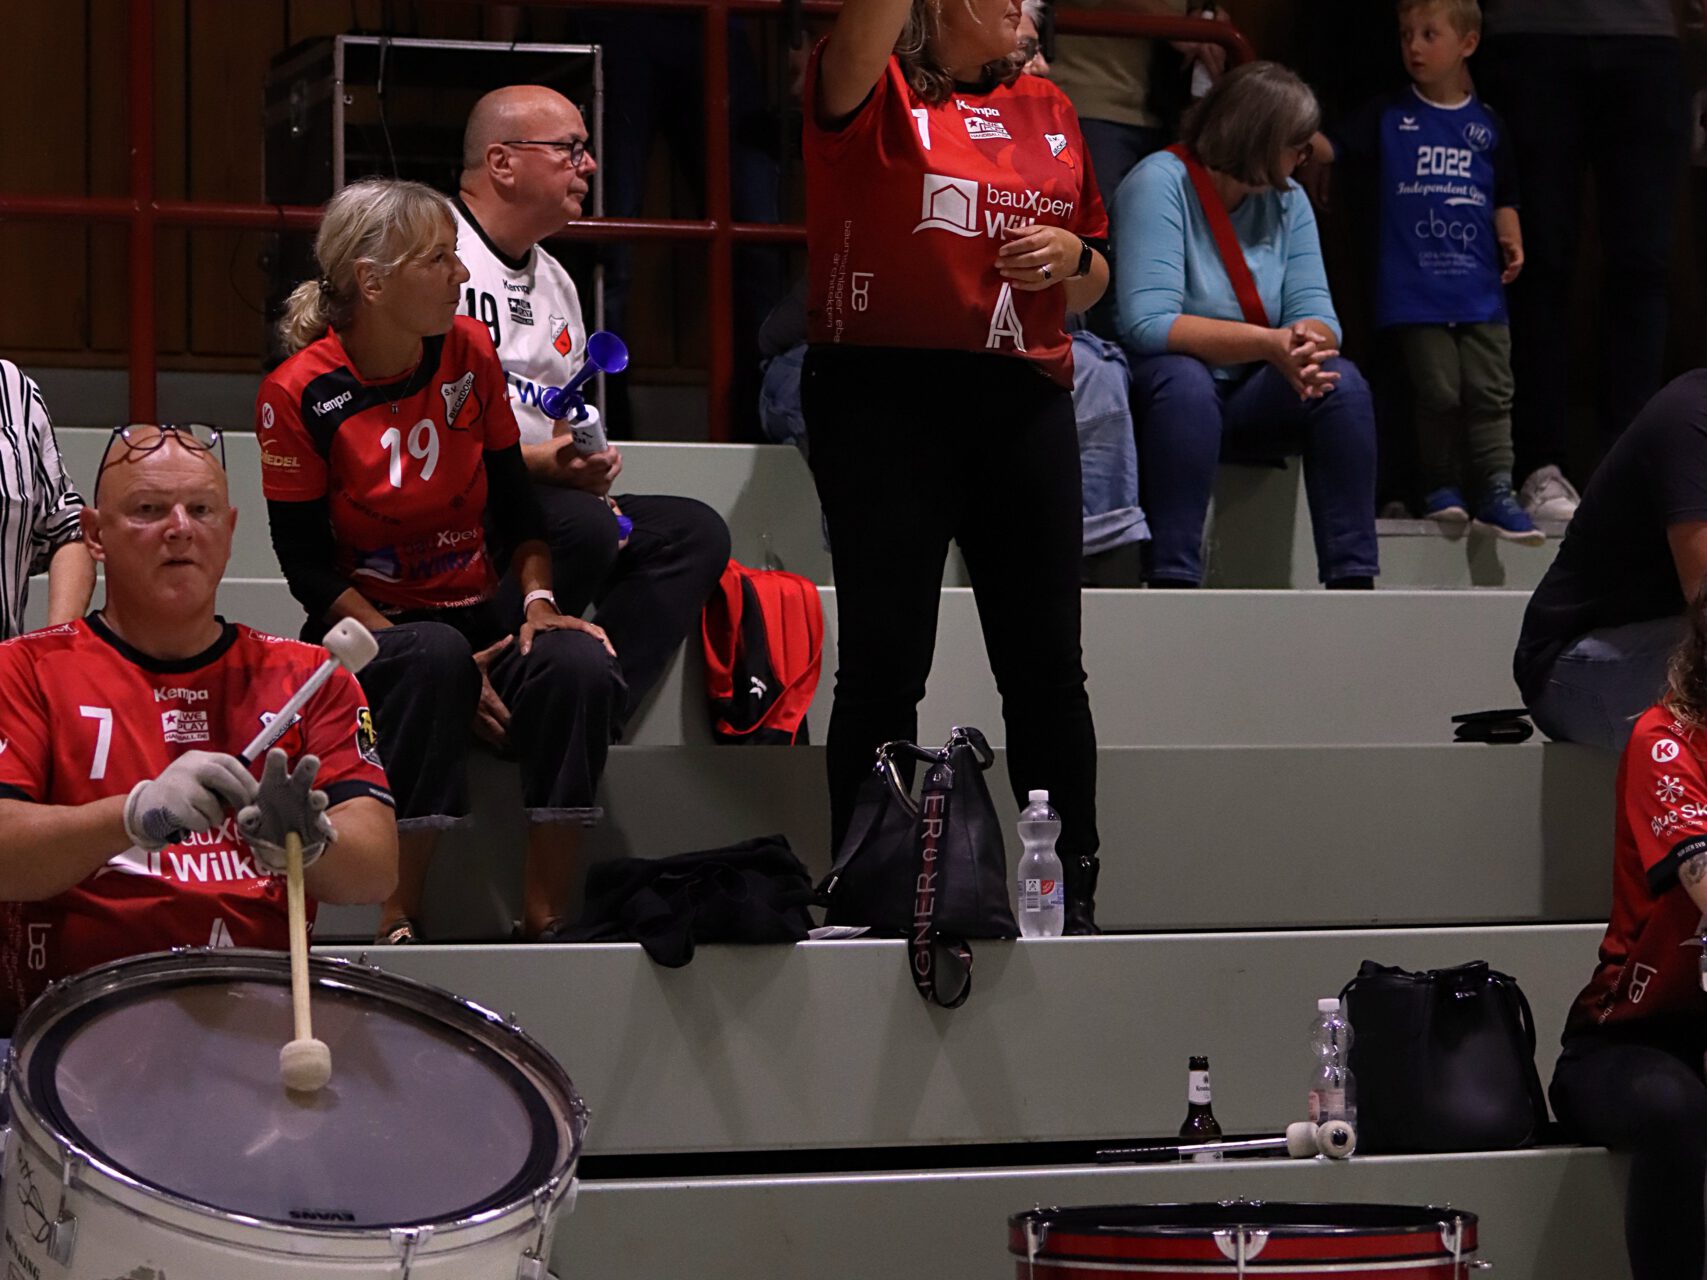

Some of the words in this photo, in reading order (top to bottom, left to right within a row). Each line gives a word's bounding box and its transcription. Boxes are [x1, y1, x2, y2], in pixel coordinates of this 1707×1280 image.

[1416, 146, 1472, 178] 2022
[312, 390, 353, 417] Kempa
[380, 418, 440, 488] 19
[153, 686, 209, 705] Kempa
[79, 705, 113, 780] 7
[168, 850, 258, 882] Wilk
